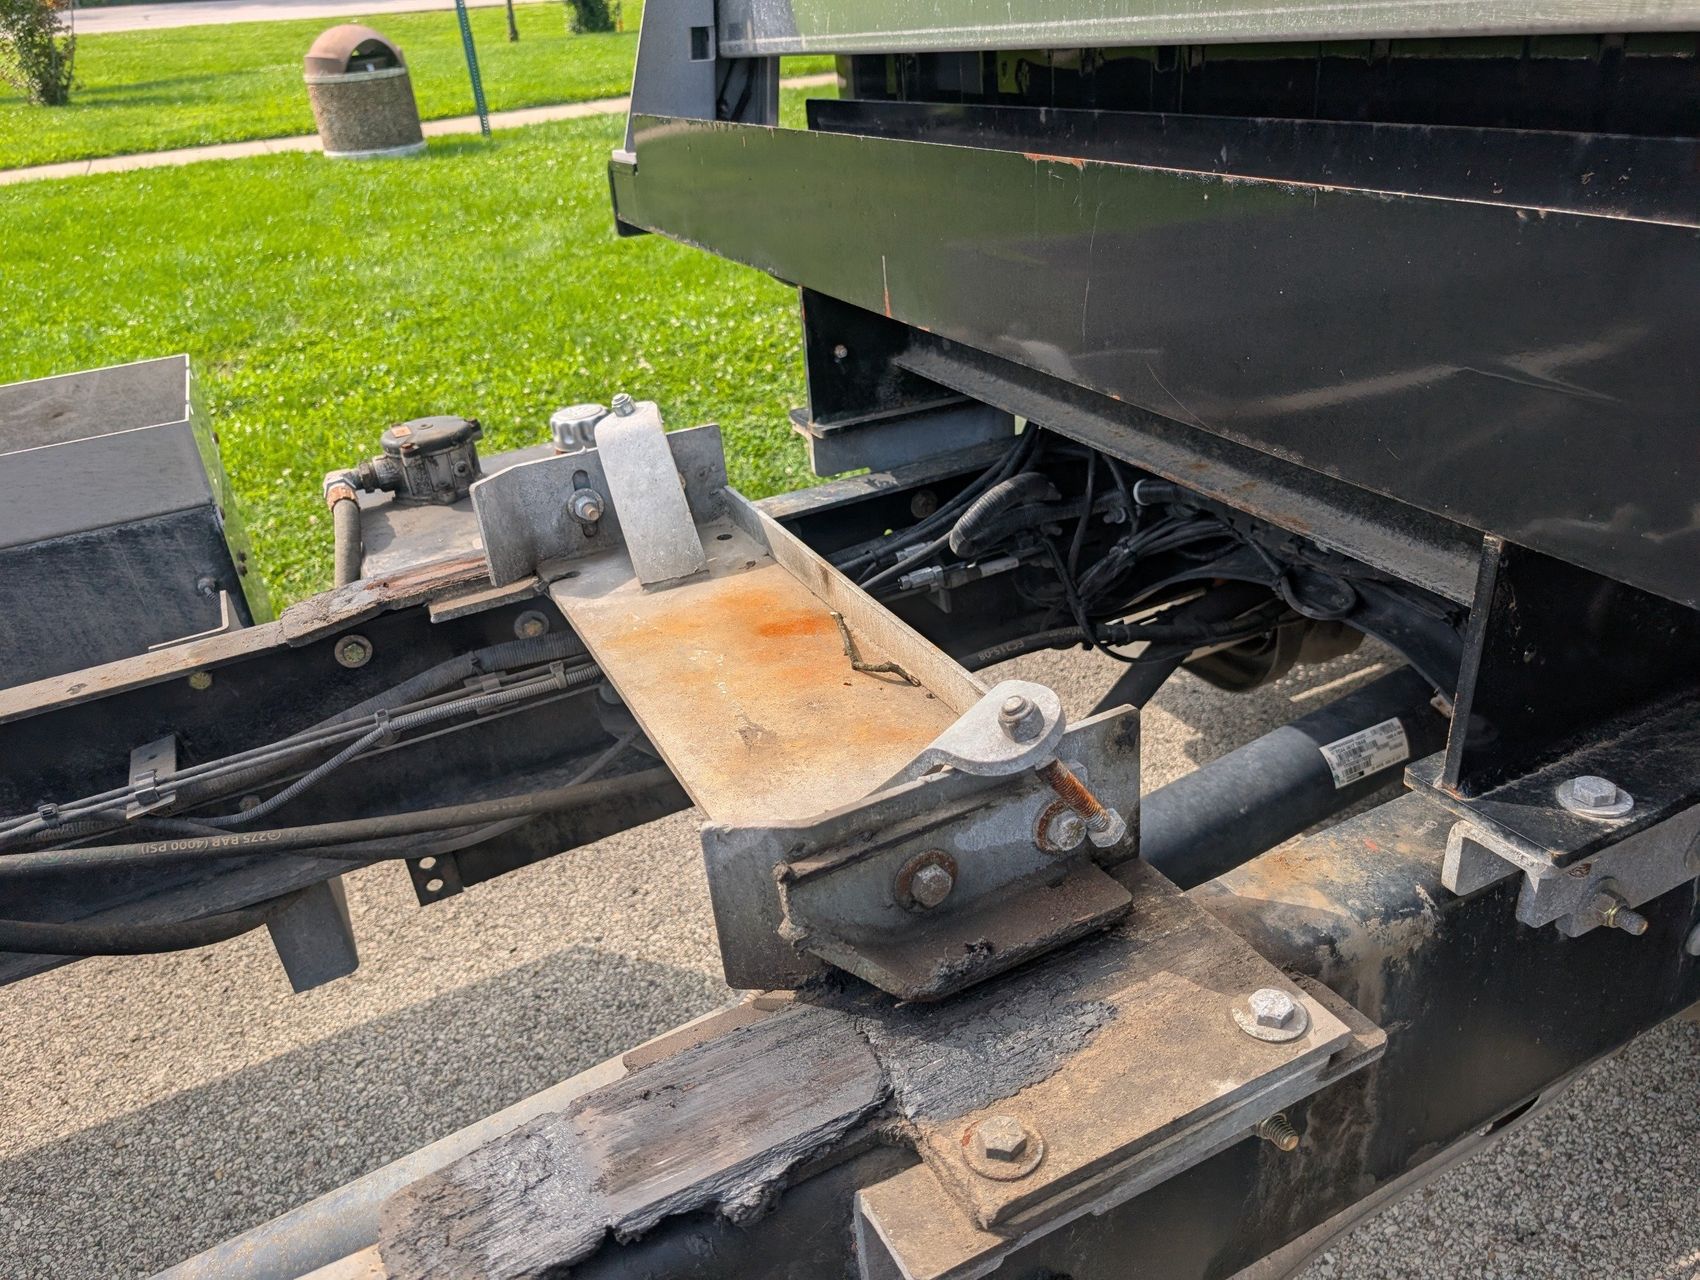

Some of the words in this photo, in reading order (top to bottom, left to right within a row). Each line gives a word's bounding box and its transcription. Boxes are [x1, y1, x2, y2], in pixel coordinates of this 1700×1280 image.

[212, 837, 239, 847] BAR
[243, 833, 267, 844] 275
[141, 843, 167, 855] PSI)
[171, 840, 209, 851] (4000
